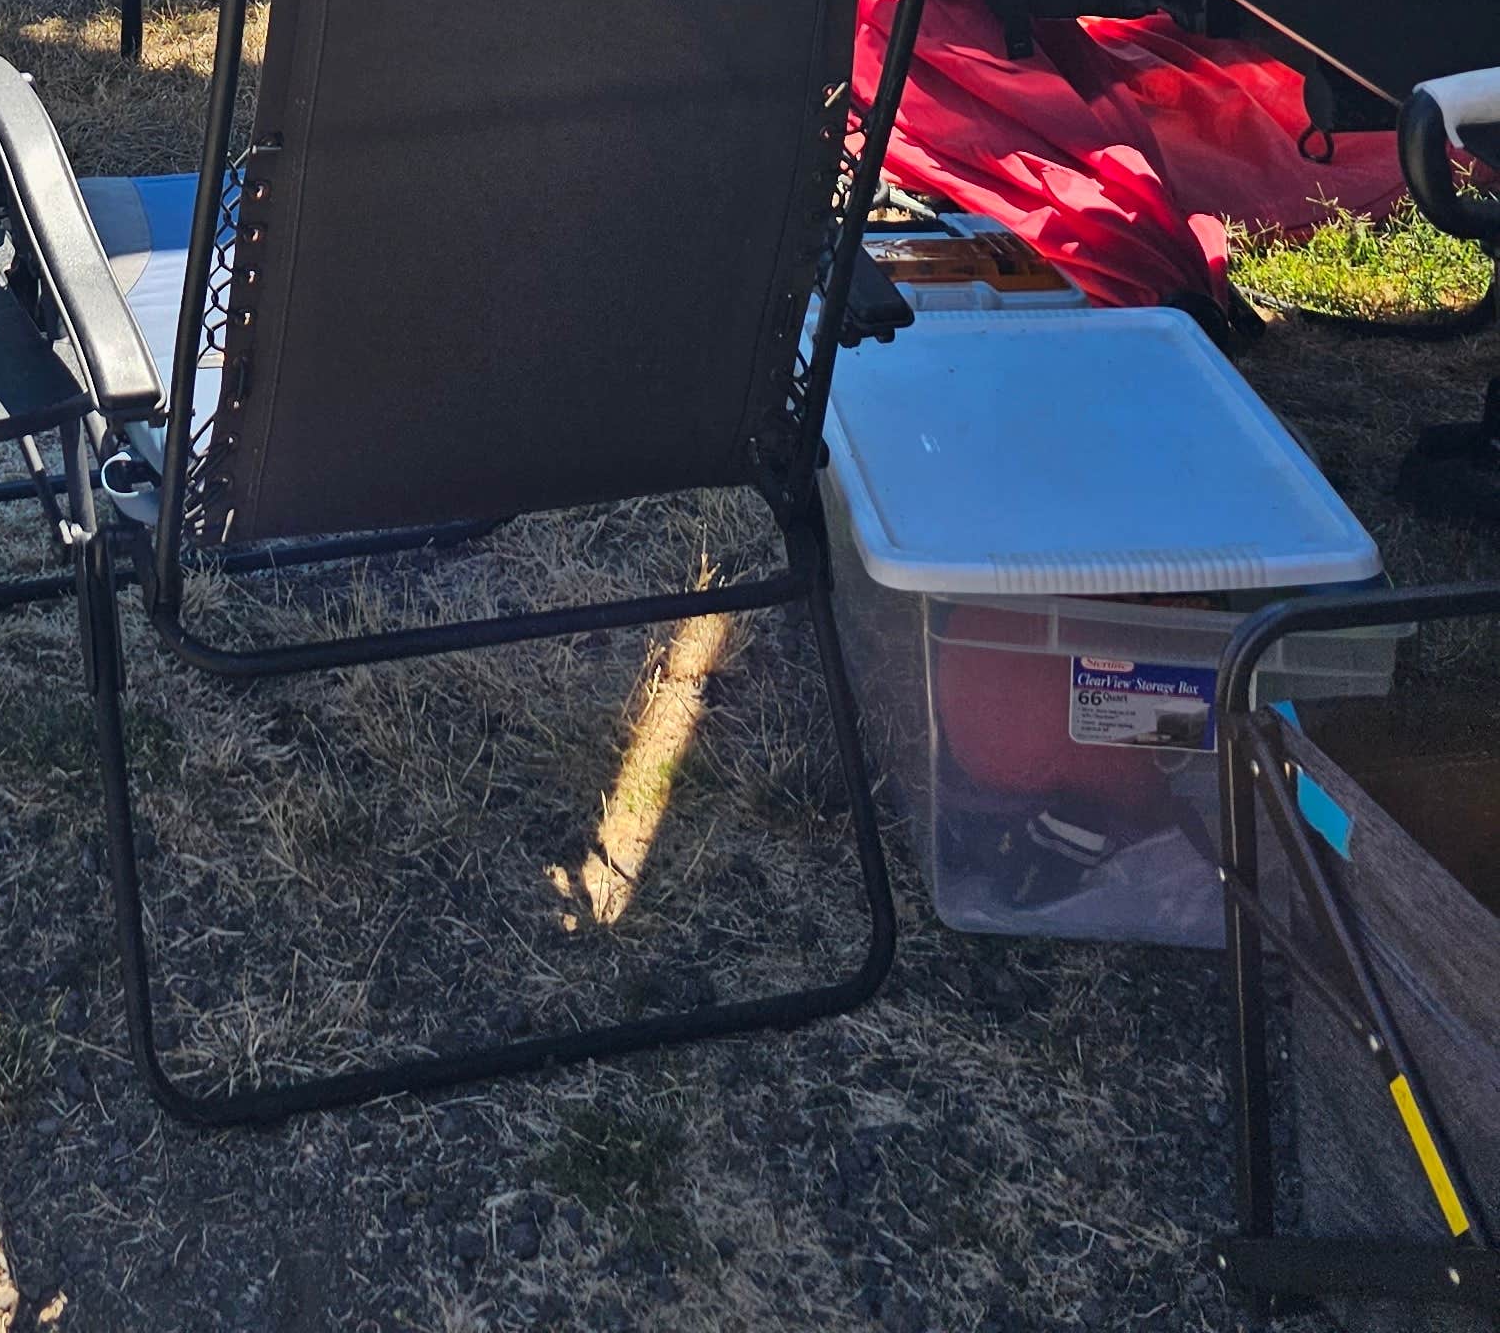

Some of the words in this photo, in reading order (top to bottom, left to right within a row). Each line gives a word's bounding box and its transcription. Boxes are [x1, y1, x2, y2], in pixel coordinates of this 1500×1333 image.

[1077, 671, 1132, 689] ClearView
[1135, 676, 1176, 694] Storage
[1178, 679, 1200, 695] Box
[1078, 689, 1102, 706] 66
